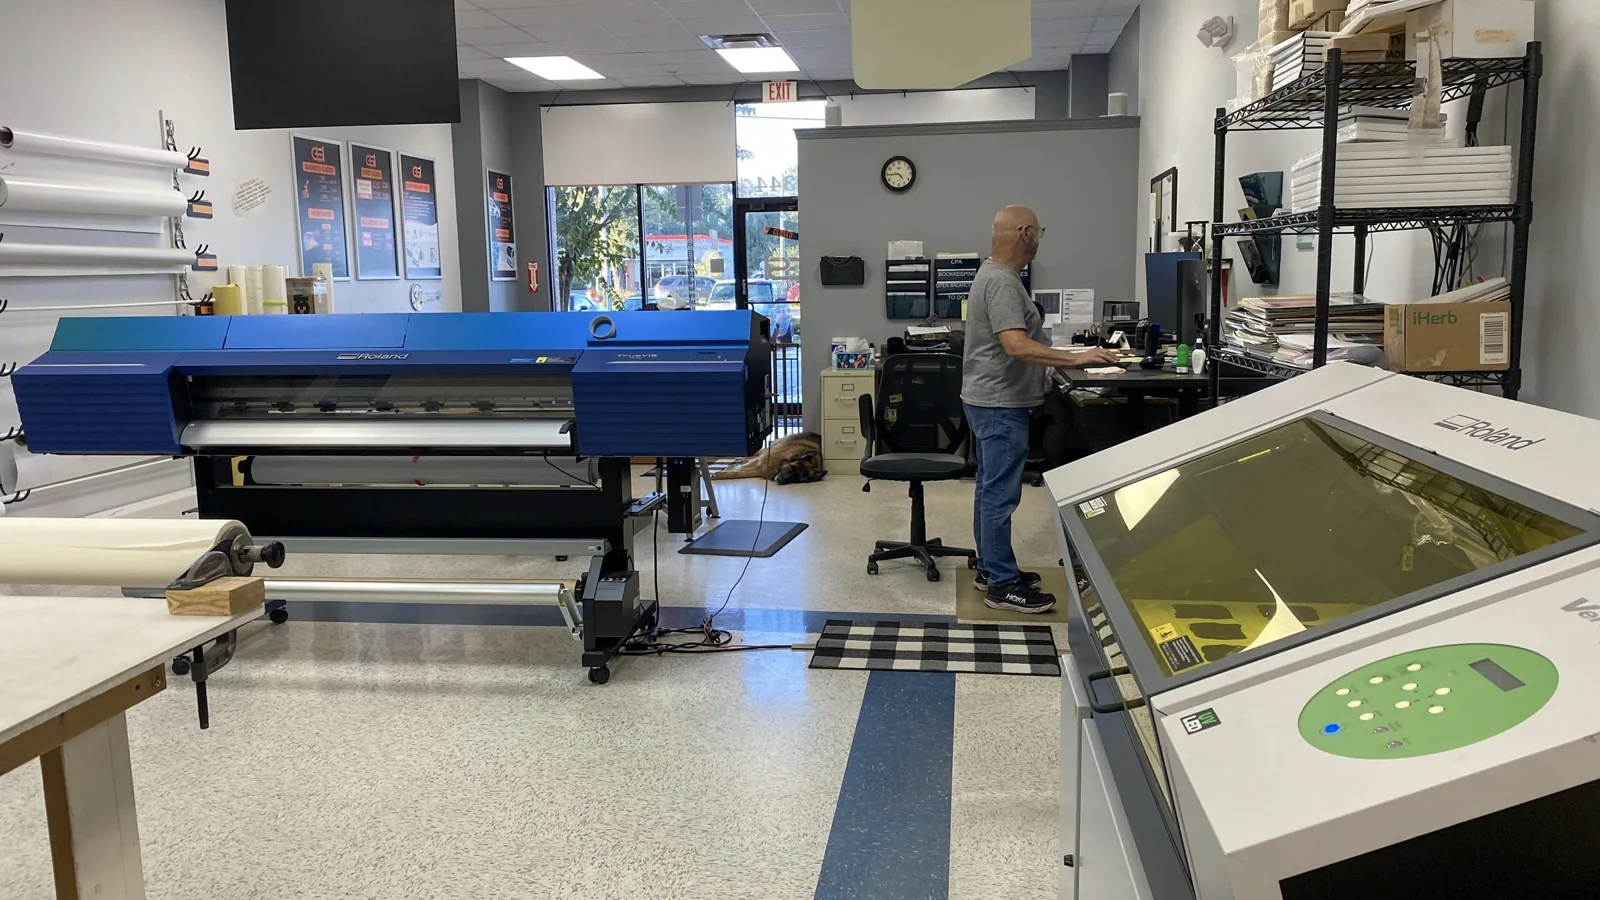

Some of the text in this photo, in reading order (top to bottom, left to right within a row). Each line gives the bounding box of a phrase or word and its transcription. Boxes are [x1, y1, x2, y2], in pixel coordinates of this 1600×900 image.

[769, 82, 791, 100] EXIT
[773, 228, 793, 239] CLOSED
[1413, 311, 1458, 325] iHerb
[1456, 421, 1546, 450] Roland
[1005, 593, 1026, 604] HOKA
[1182, 715, 1203, 733] LED
[1197, 711, 1217, 725] UV
